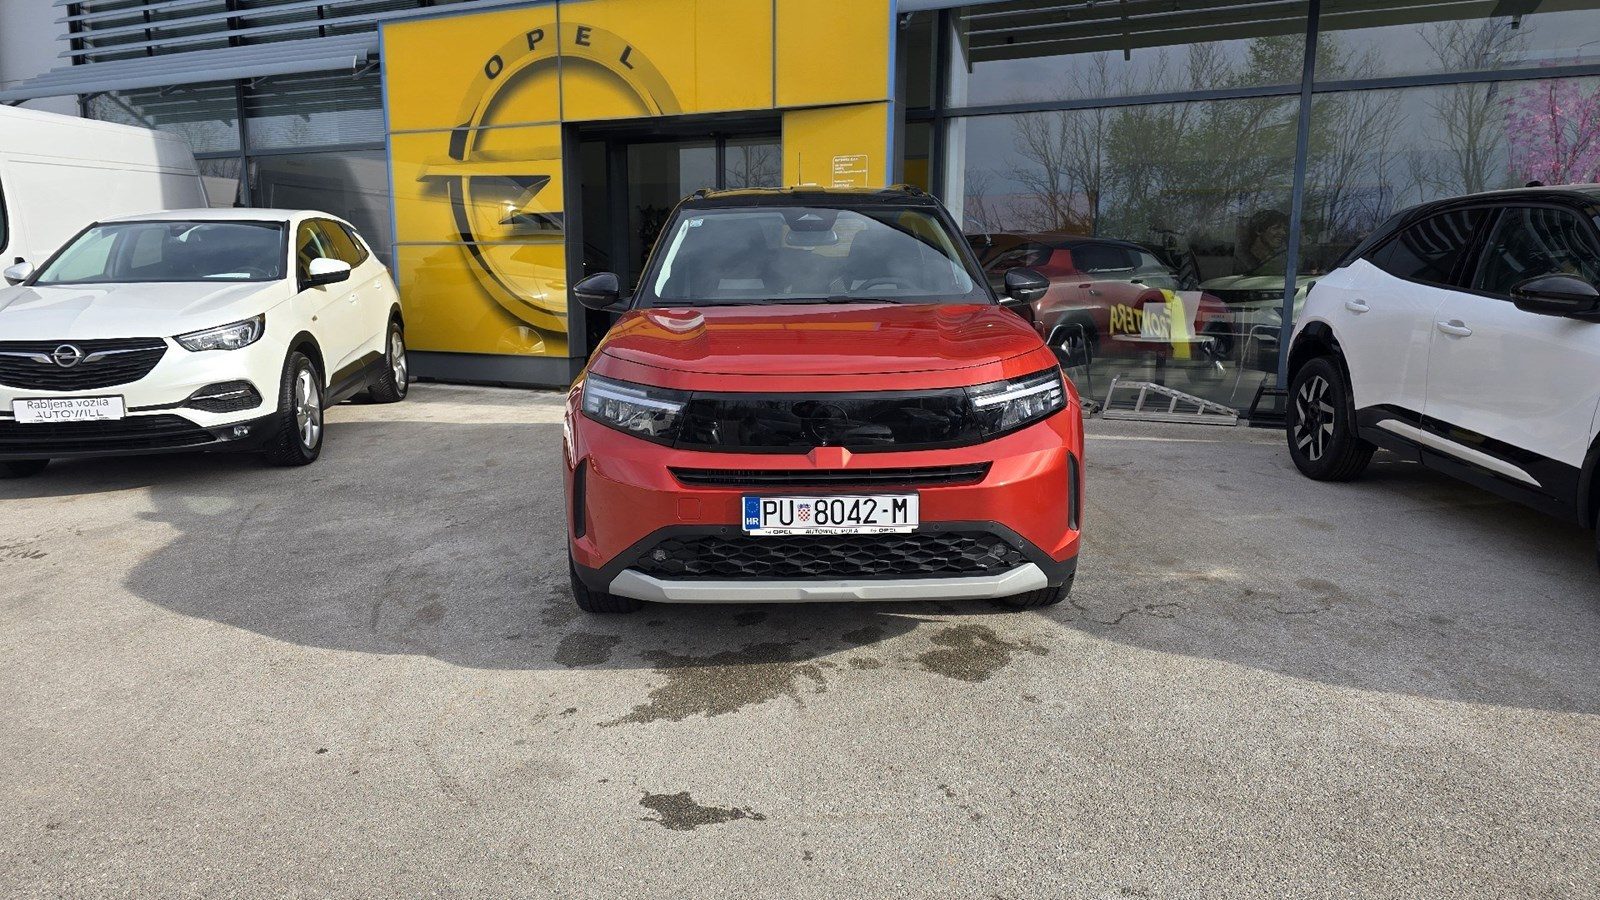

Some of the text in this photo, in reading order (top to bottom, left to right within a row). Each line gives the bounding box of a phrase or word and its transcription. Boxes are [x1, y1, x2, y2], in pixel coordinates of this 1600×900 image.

[484, 25, 635, 81] OPEL
[27, 398, 109, 410] Rabljena vozila
[35, 409, 104, 418] AUTOWILL
[763, 498, 908, 526] PU 8042-M
[746, 517, 759, 526] HR
